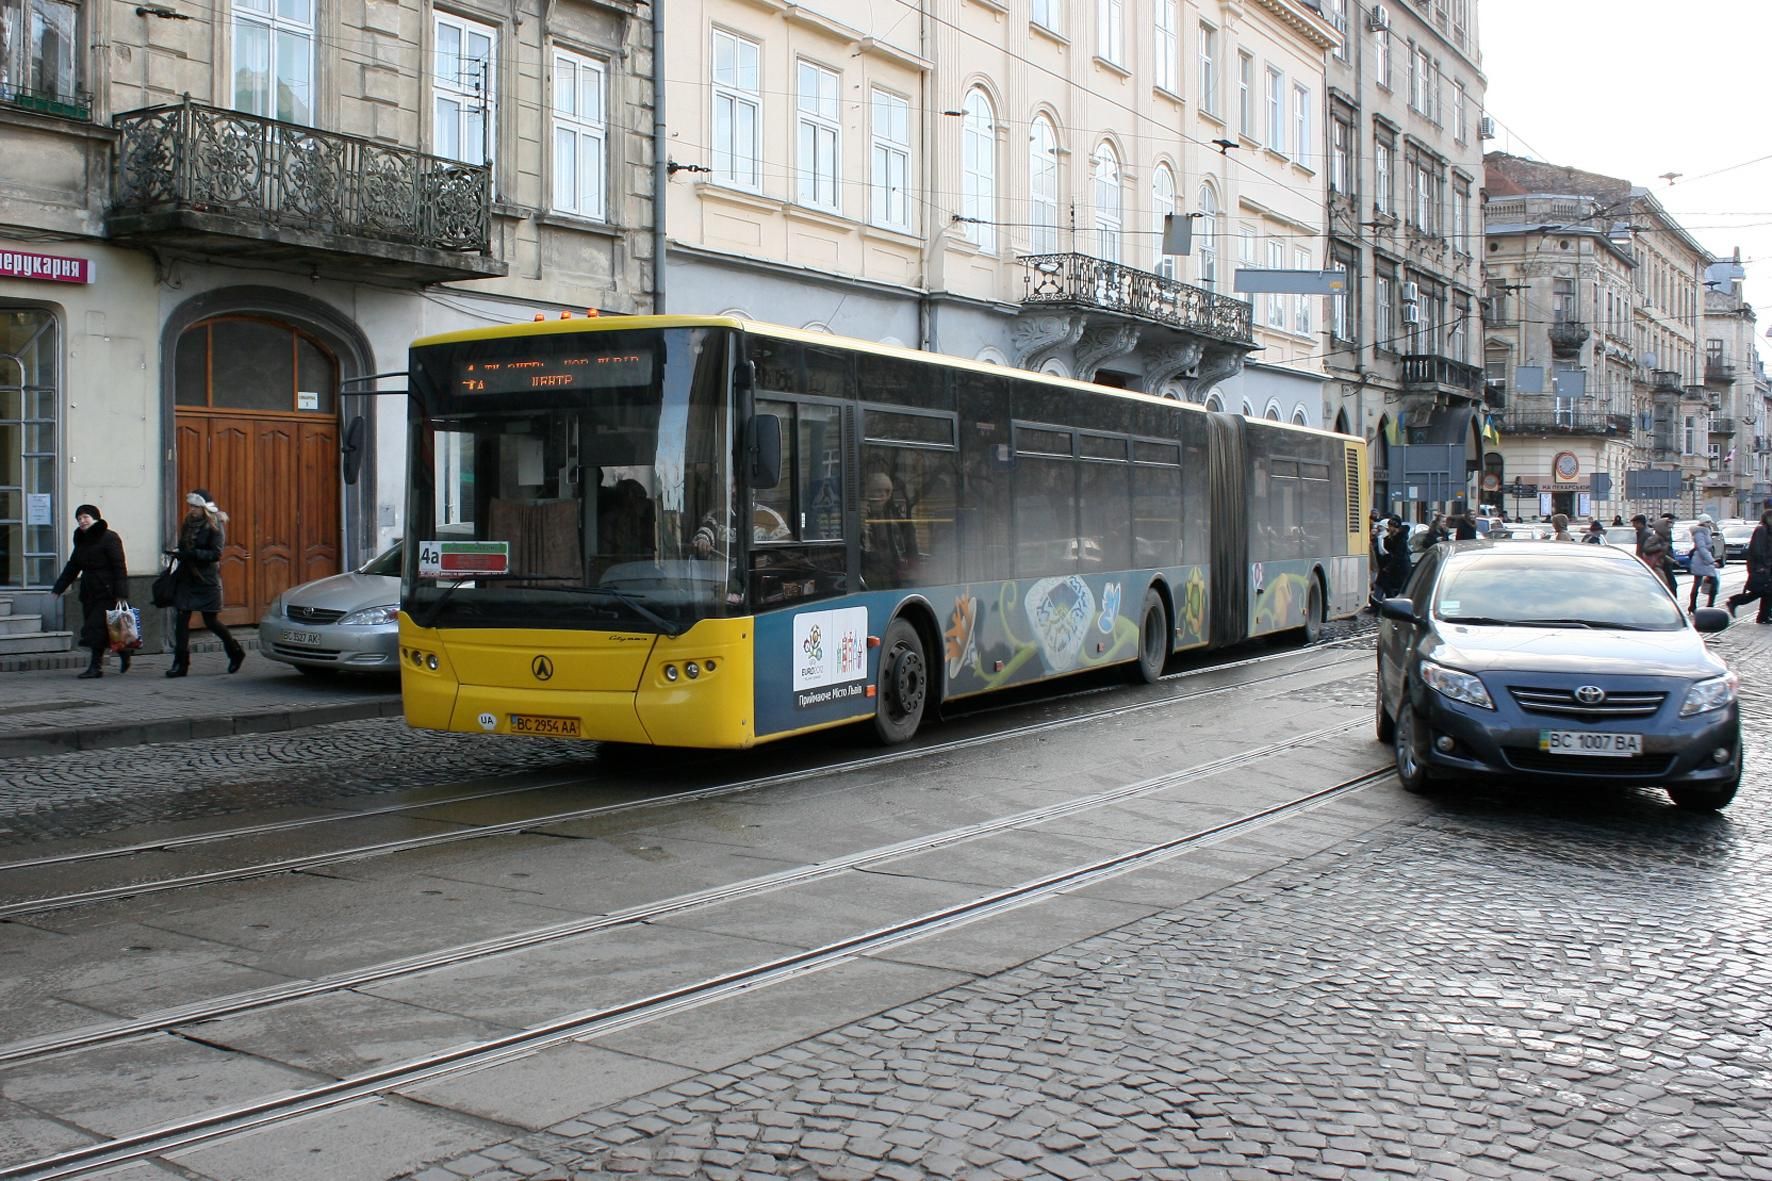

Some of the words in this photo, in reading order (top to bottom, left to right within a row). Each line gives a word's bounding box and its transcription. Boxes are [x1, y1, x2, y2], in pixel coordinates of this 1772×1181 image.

[421, 547, 439, 564] 4а
[799, 691, 831, 708] Приймаюче
[832, 686, 847, 699] Місто
[847, 682, 862, 695] Львів
[480, 716, 493, 725] UA
[517, 718, 532, 731] BC
[535, 719, 559, 732] 2954
[562, 721, 577, 734] AA
[1551, 733, 1572, 748] BC
[1577, 735, 1611, 749] 1007
[1615, 736, 1638, 750] BA
